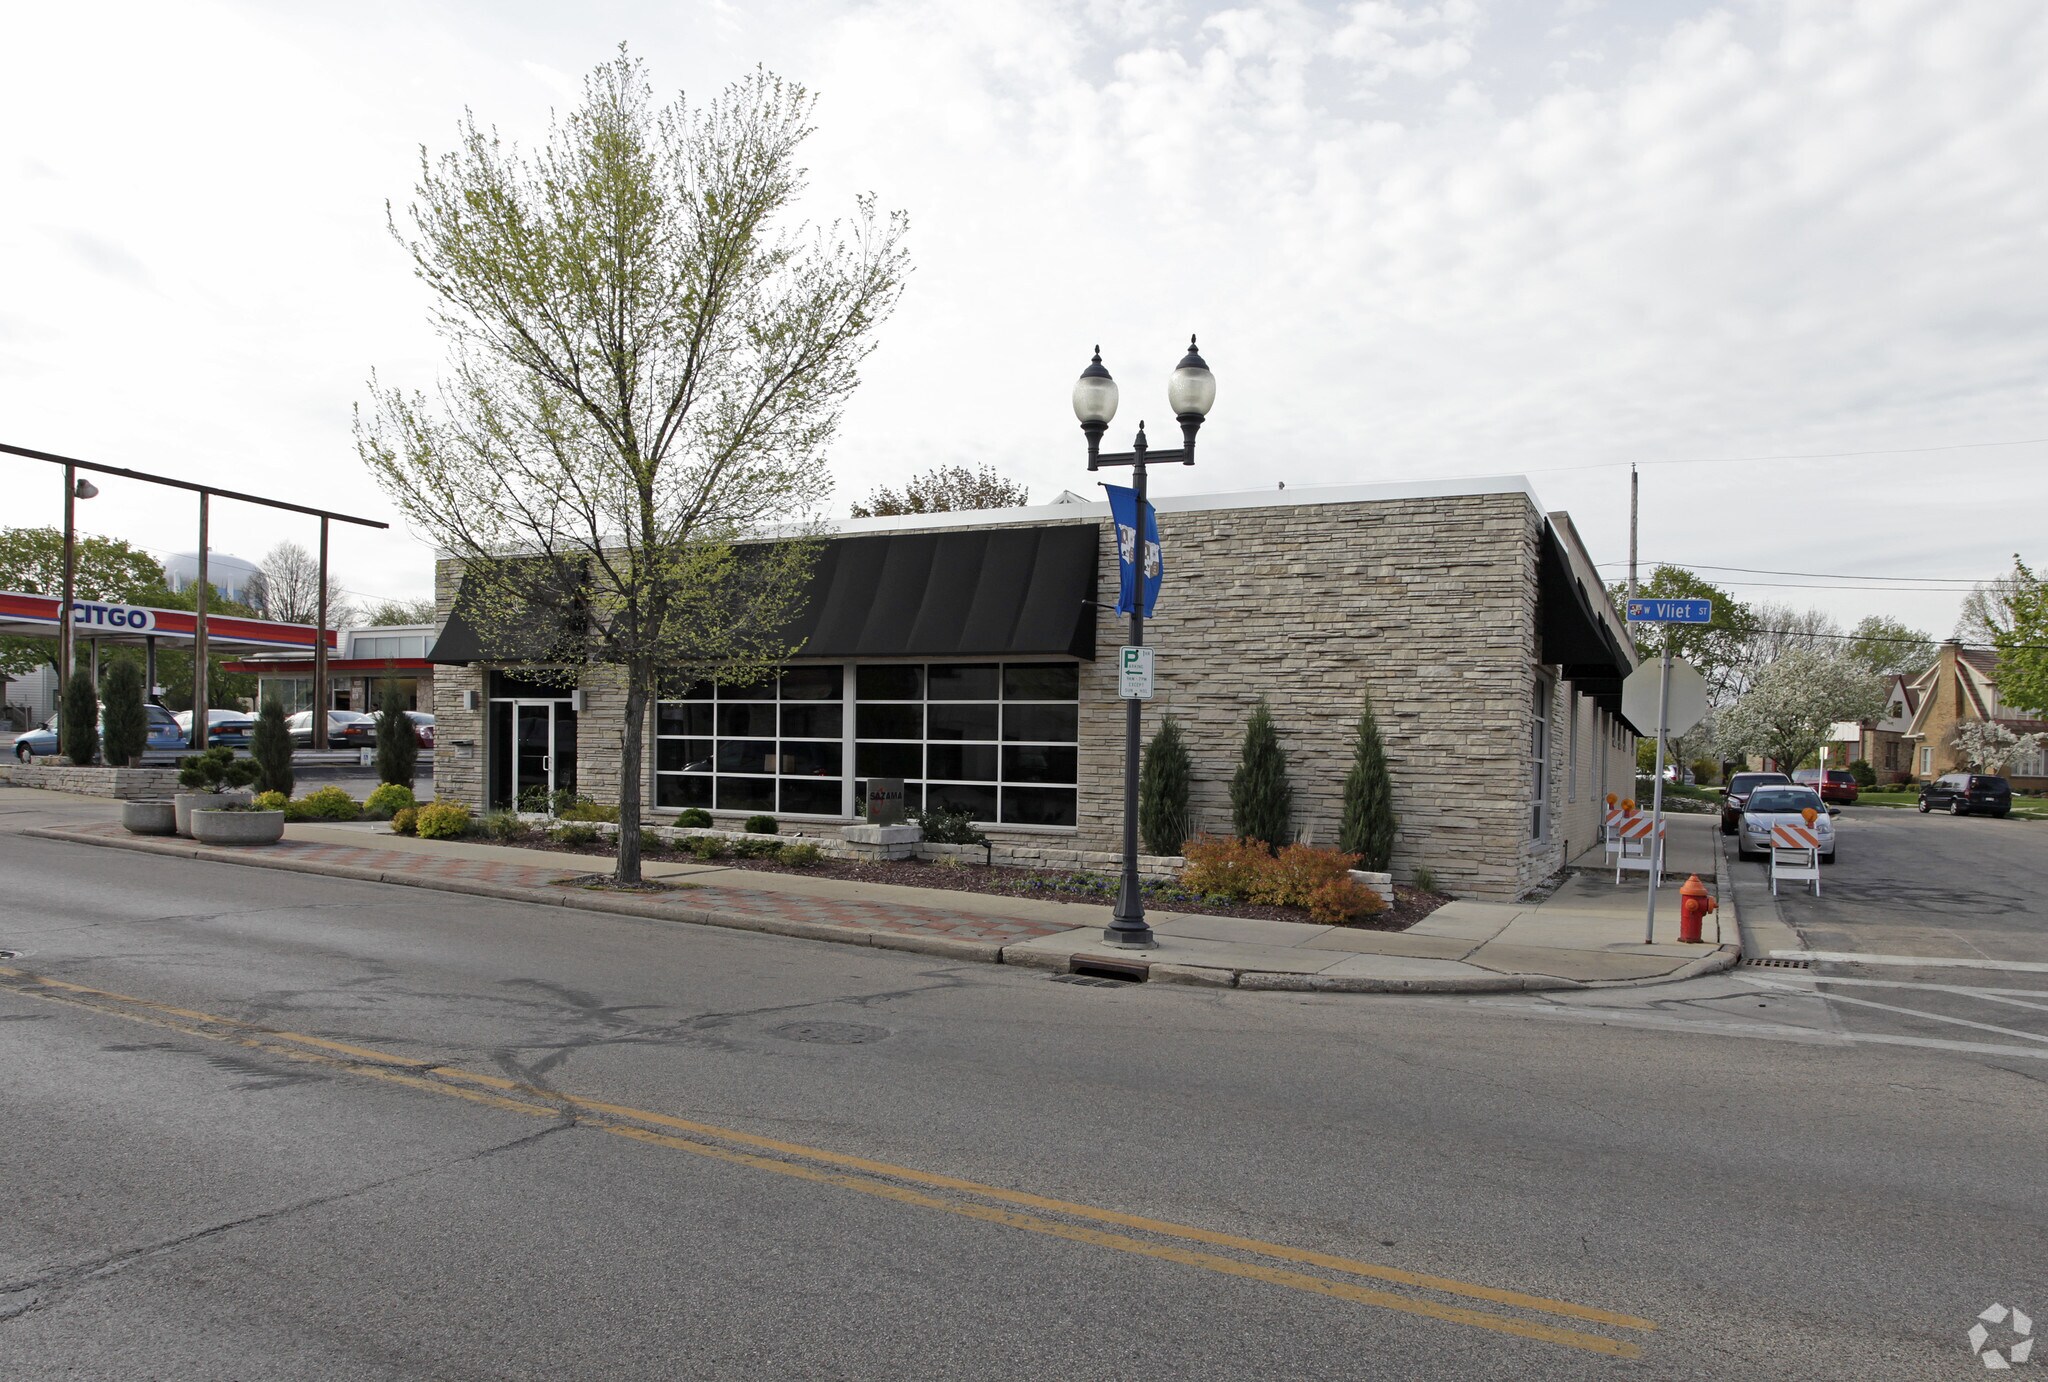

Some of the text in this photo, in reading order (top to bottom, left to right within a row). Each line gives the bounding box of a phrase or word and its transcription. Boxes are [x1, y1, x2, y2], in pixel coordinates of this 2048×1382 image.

[72, 603, 147, 629] CITGO
[1643, 606, 1650, 614] W
[1656, 603, 1691, 618] Vliet
[869, 791, 903, 801] SAZAMA
